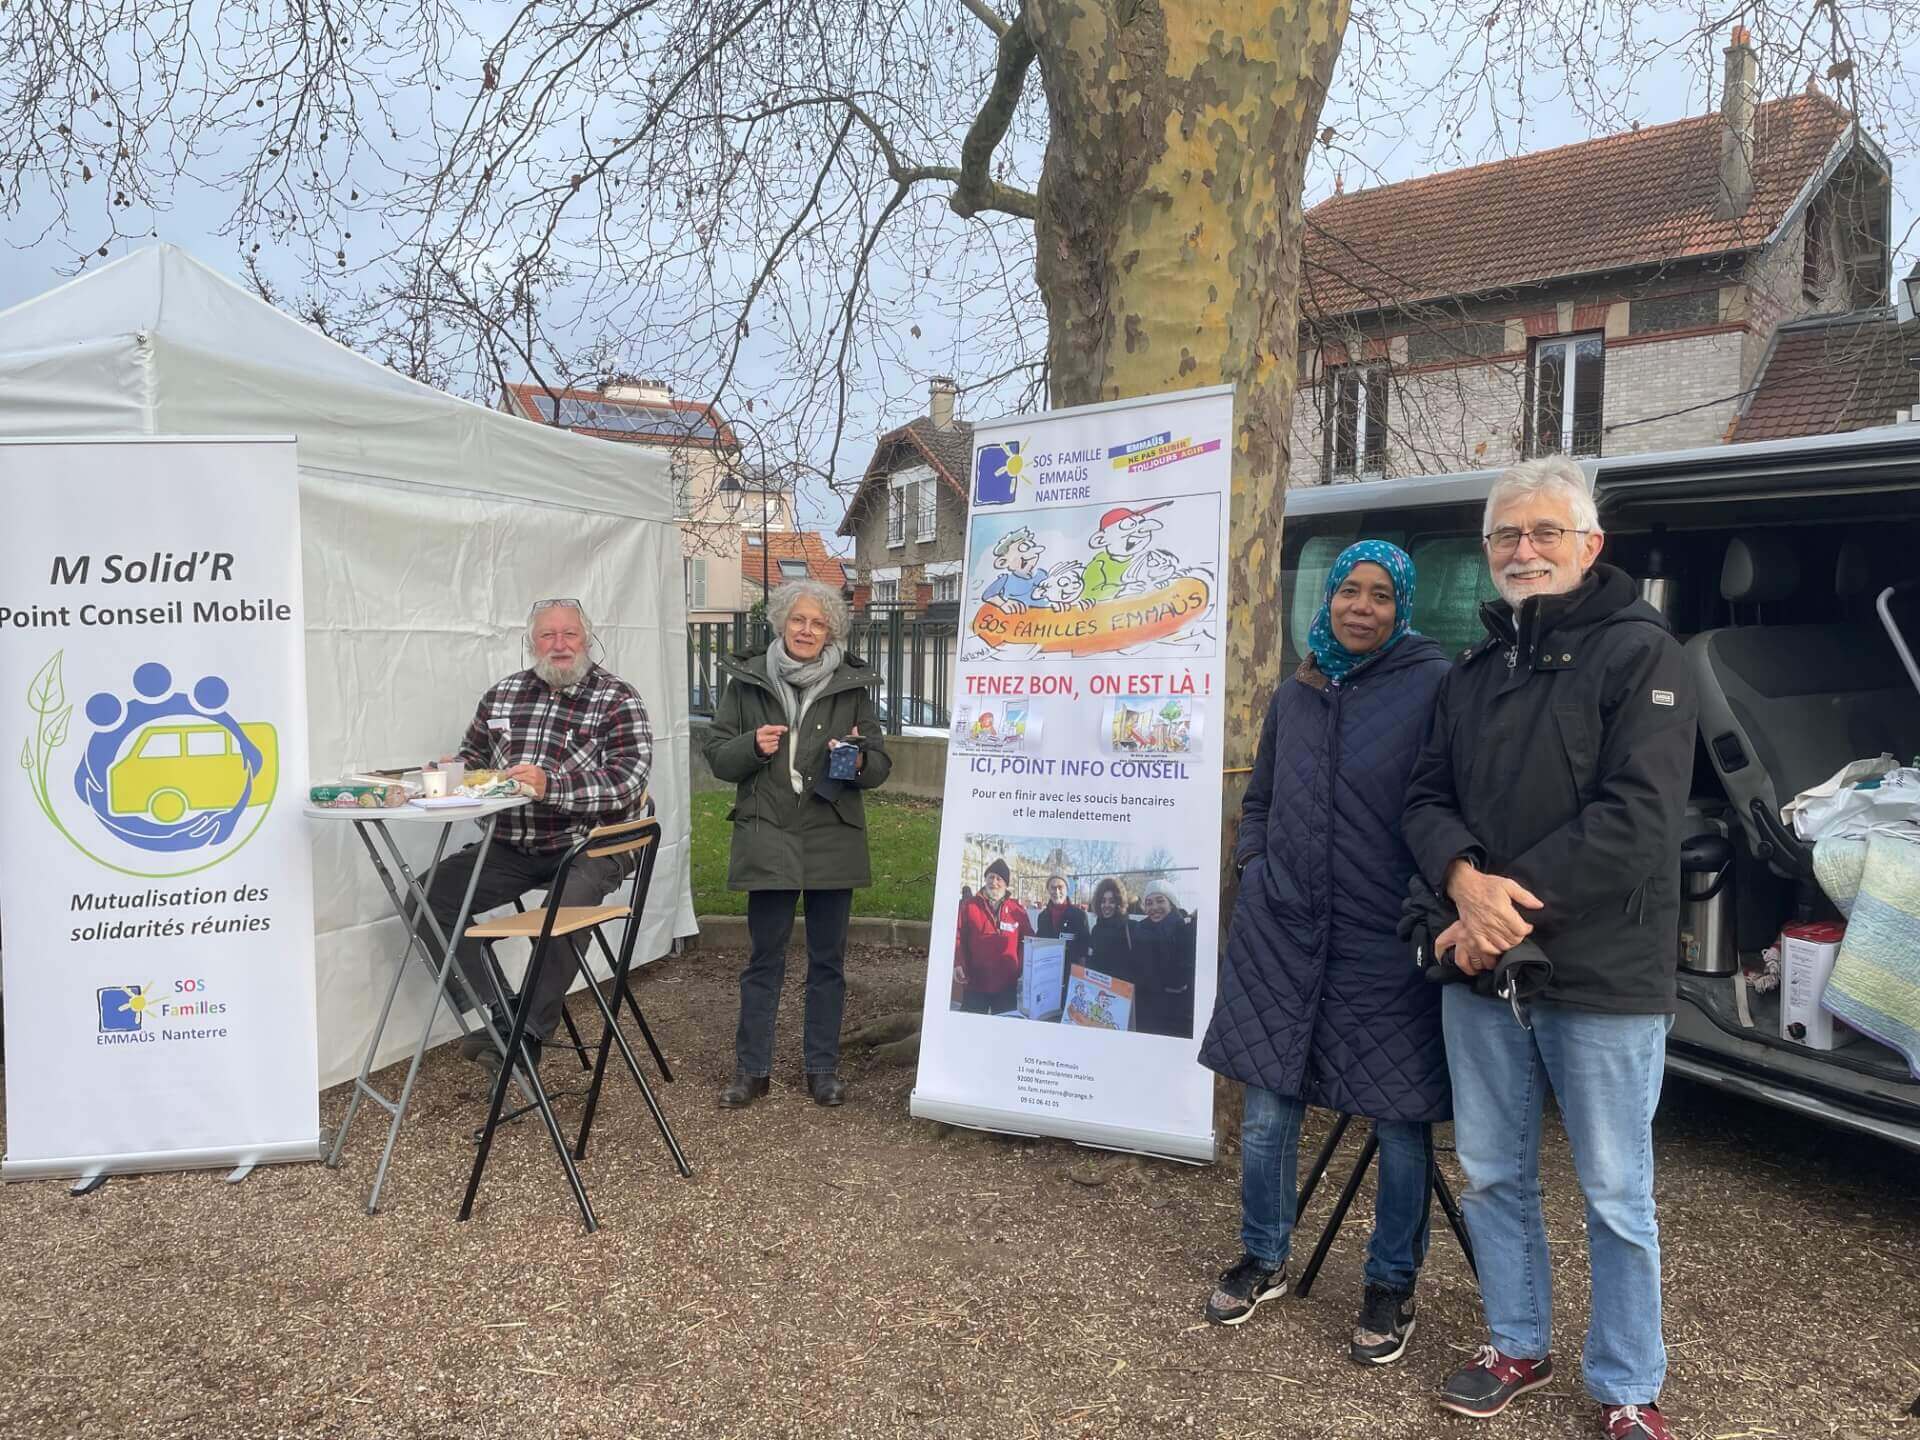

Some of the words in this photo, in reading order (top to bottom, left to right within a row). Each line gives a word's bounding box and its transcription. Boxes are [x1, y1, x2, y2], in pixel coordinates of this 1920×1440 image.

[1126, 435, 1165, 453] EMMAÜS
[1128, 456, 1140, 465] NE
[1141, 449, 1156, 460] PAS
[1158, 440, 1187, 454] SUBIR
[1033, 454, 1053, 469] SOS
[1058, 449, 1102, 466] FAMILLE
[1132, 453, 1178, 473] TOUJOURS
[1180, 446, 1205, 458] AGIR
[1039, 467, 1088, 485] EMMAÜS
[1035, 486, 1091, 503] NANTERRE
[50, 555, 90, 585] M
[0, 605, 71, 629] Point
[79, 601, 183, 626] Conseil
[193, 598, 292, 624] Mobile
[978, 614, 1008, 634] SOS
[1013, 620, 1097, 638] FAMILLES
[1112, 591, 1203, 632] EMMAÜS
[966, 674, 1024, 695] TENEZ
[1030, 675, 1080, 700] BON,
[1089, 674, 1121, 694] ON
[1127, 674, 1163, 694] EST
[1169, 668, 1195, 694] LÀ
[1204, 674, 1211, 695] !
[970, 757, 996, 776] ICI,
[1000, 758, 1056, 776] POINT
[1061, 759, 1105, 778] INFO
[1110, 761, 1190, 780] CONSEIL
[972, 788, 997, 800] Pour
[999, 791, 1013, 800] en
[1014, 789, 1037, 801] finir
[1039, 792, 1064, 802] avec
[1066, 791, 1082, 803] les
[1084, 792, 1118, 805] soucis
[1121, 794, 1176, 808] bancaires
[1012, 807, 1024, 818] et
[1025, 807, 1036, 818] le
[1038, 808, 1132, 823] malendettement
[70, 886, 227, 912] Mutualisation
[233, 884, 269, 902] des
[70, 917, 185, 942] solidarités
[191, 913, 271, 936] réunies
[174, 977, 206, 994] SOS
[161, 1000, 227, 1018] Familles
[97, 1030, 156, 1046] EMMAÜS
[162, 1026, 228, 1042] Nanterre
[1024, 1056, 1035, 1064] SOS
[1036, 1058, 1055, 1067] Famille
[1036, 1067, 1046, 1075] des
[1034, 1076, 1059, 1086] Nanterre
